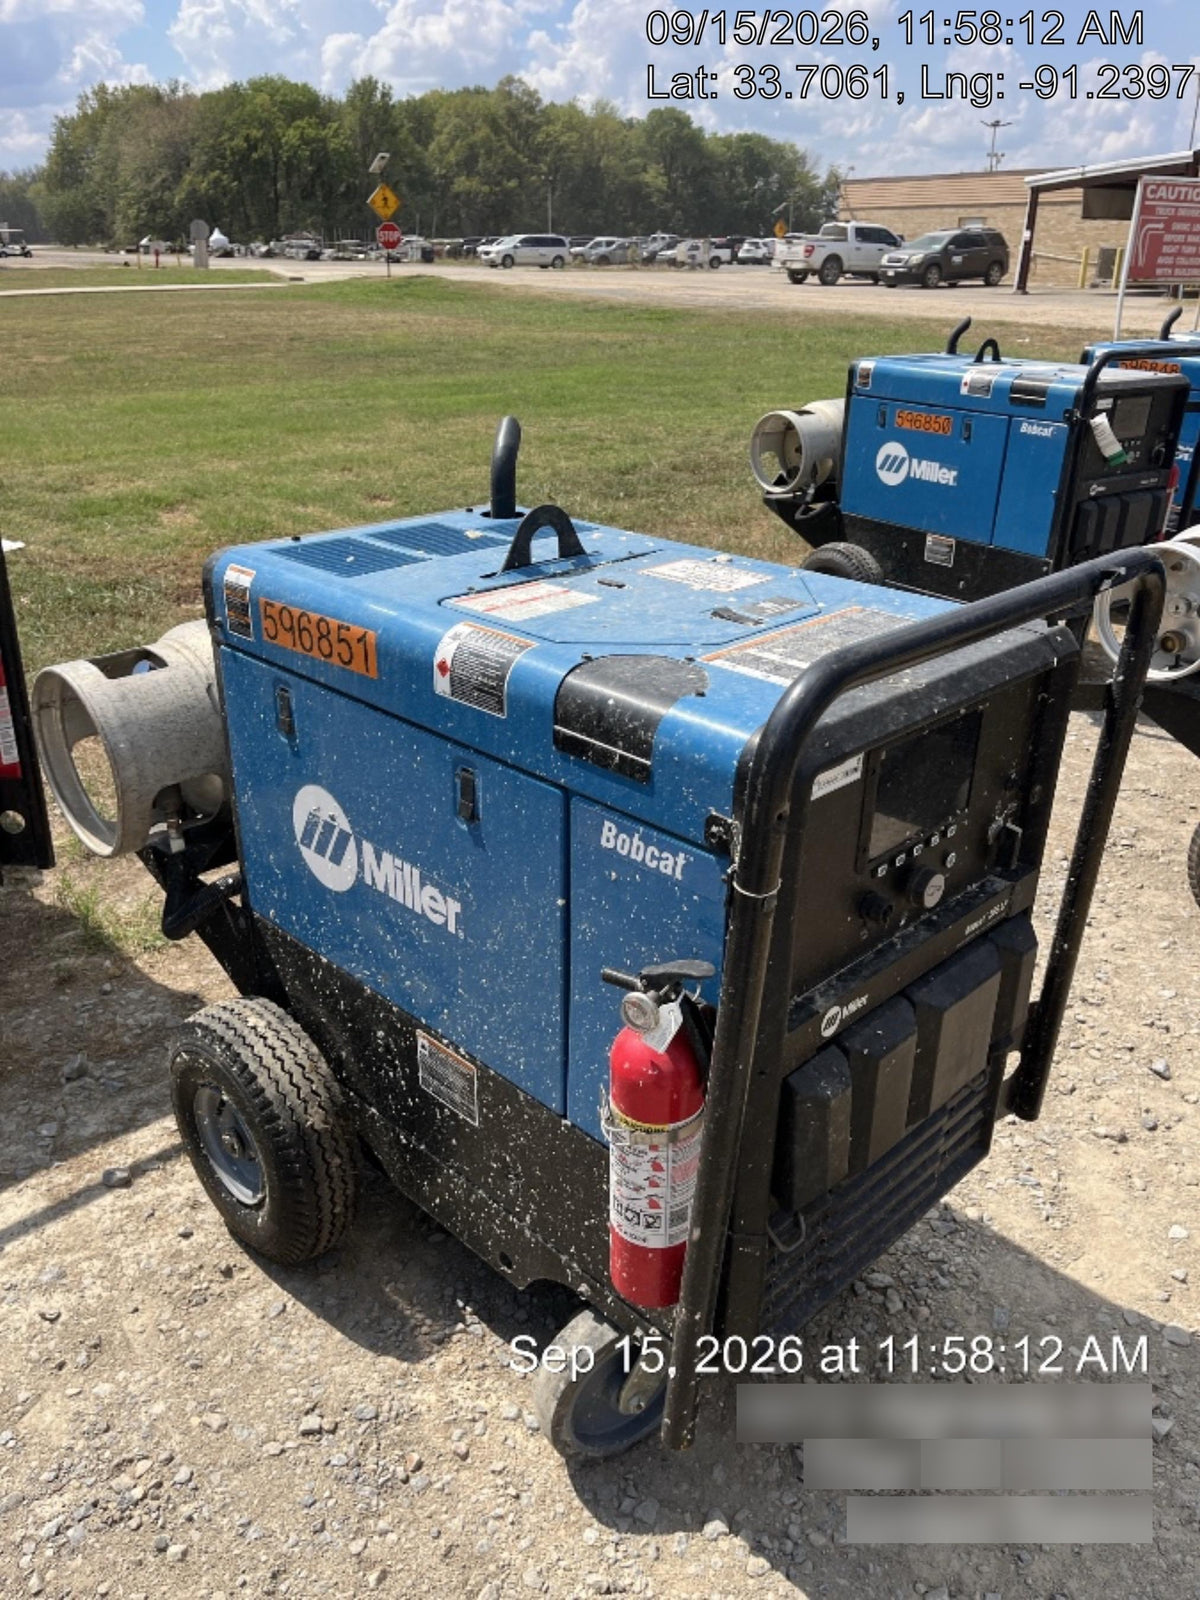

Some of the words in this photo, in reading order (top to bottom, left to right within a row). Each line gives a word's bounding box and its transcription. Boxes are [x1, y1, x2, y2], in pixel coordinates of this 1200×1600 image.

[379, 231, 400, 242] STOP
[896, 411, 952, 435] 596850
[1019, 423, 1054, 437] Bobcat
[909, 458, 958, 486] Miller
[263, 601, 370, 674] 596851
[600, 819, 687, 881] Bobcat
[361, 839, 462, 935] Miller
